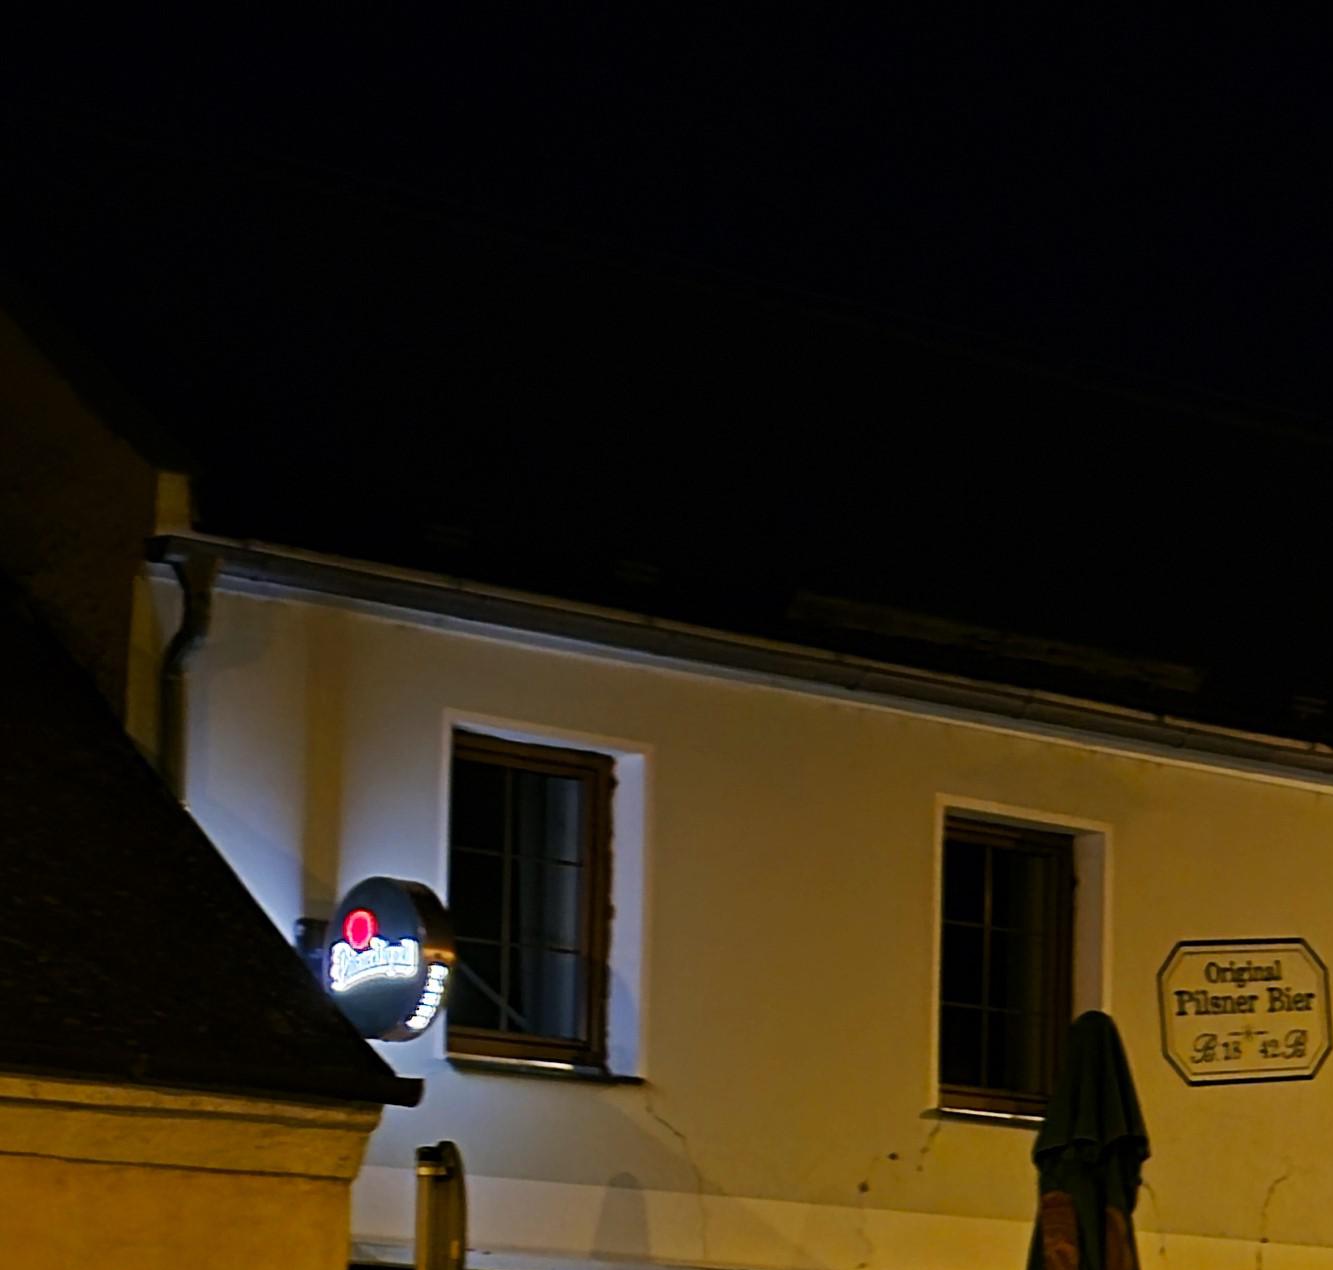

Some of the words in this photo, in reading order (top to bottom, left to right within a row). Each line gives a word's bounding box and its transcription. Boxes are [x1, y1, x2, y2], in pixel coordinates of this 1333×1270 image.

[1204, 960, 1282, 988] Original
[1174, 989, 1258, 1016] Pilsner
[1266, 987, 1315, 1012] Bier
